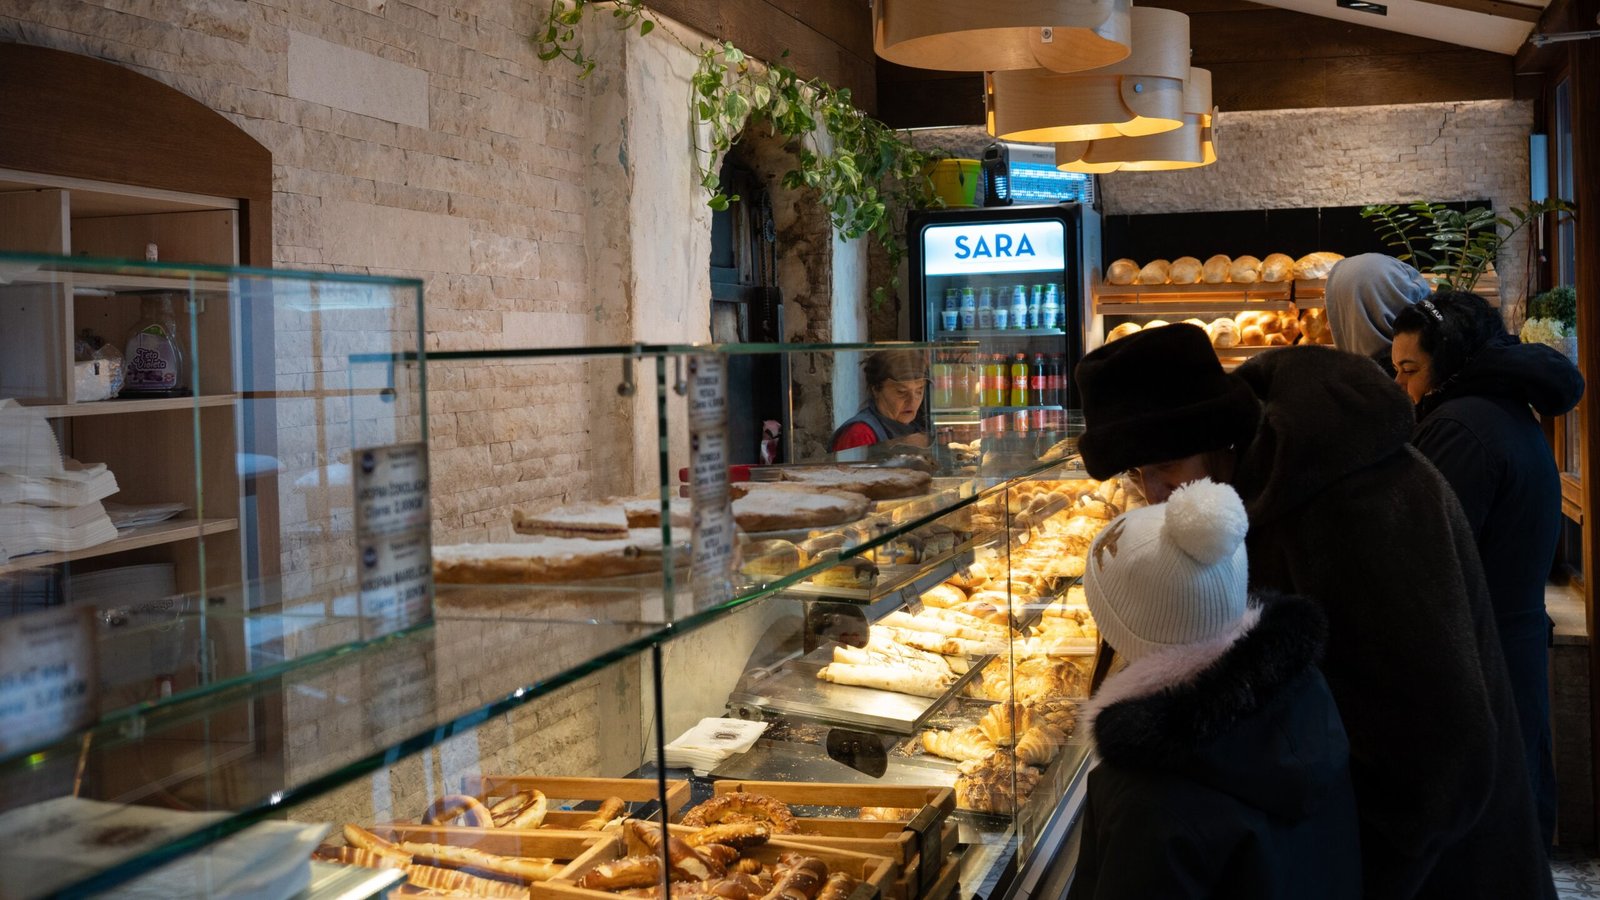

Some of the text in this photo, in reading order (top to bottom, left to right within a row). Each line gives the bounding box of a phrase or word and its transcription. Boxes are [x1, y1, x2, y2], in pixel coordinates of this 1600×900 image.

[954, 233, 1036, 259] SARA
[136, 348, 159, 360] Teta
[133, 356, 166, 370] Violeta
